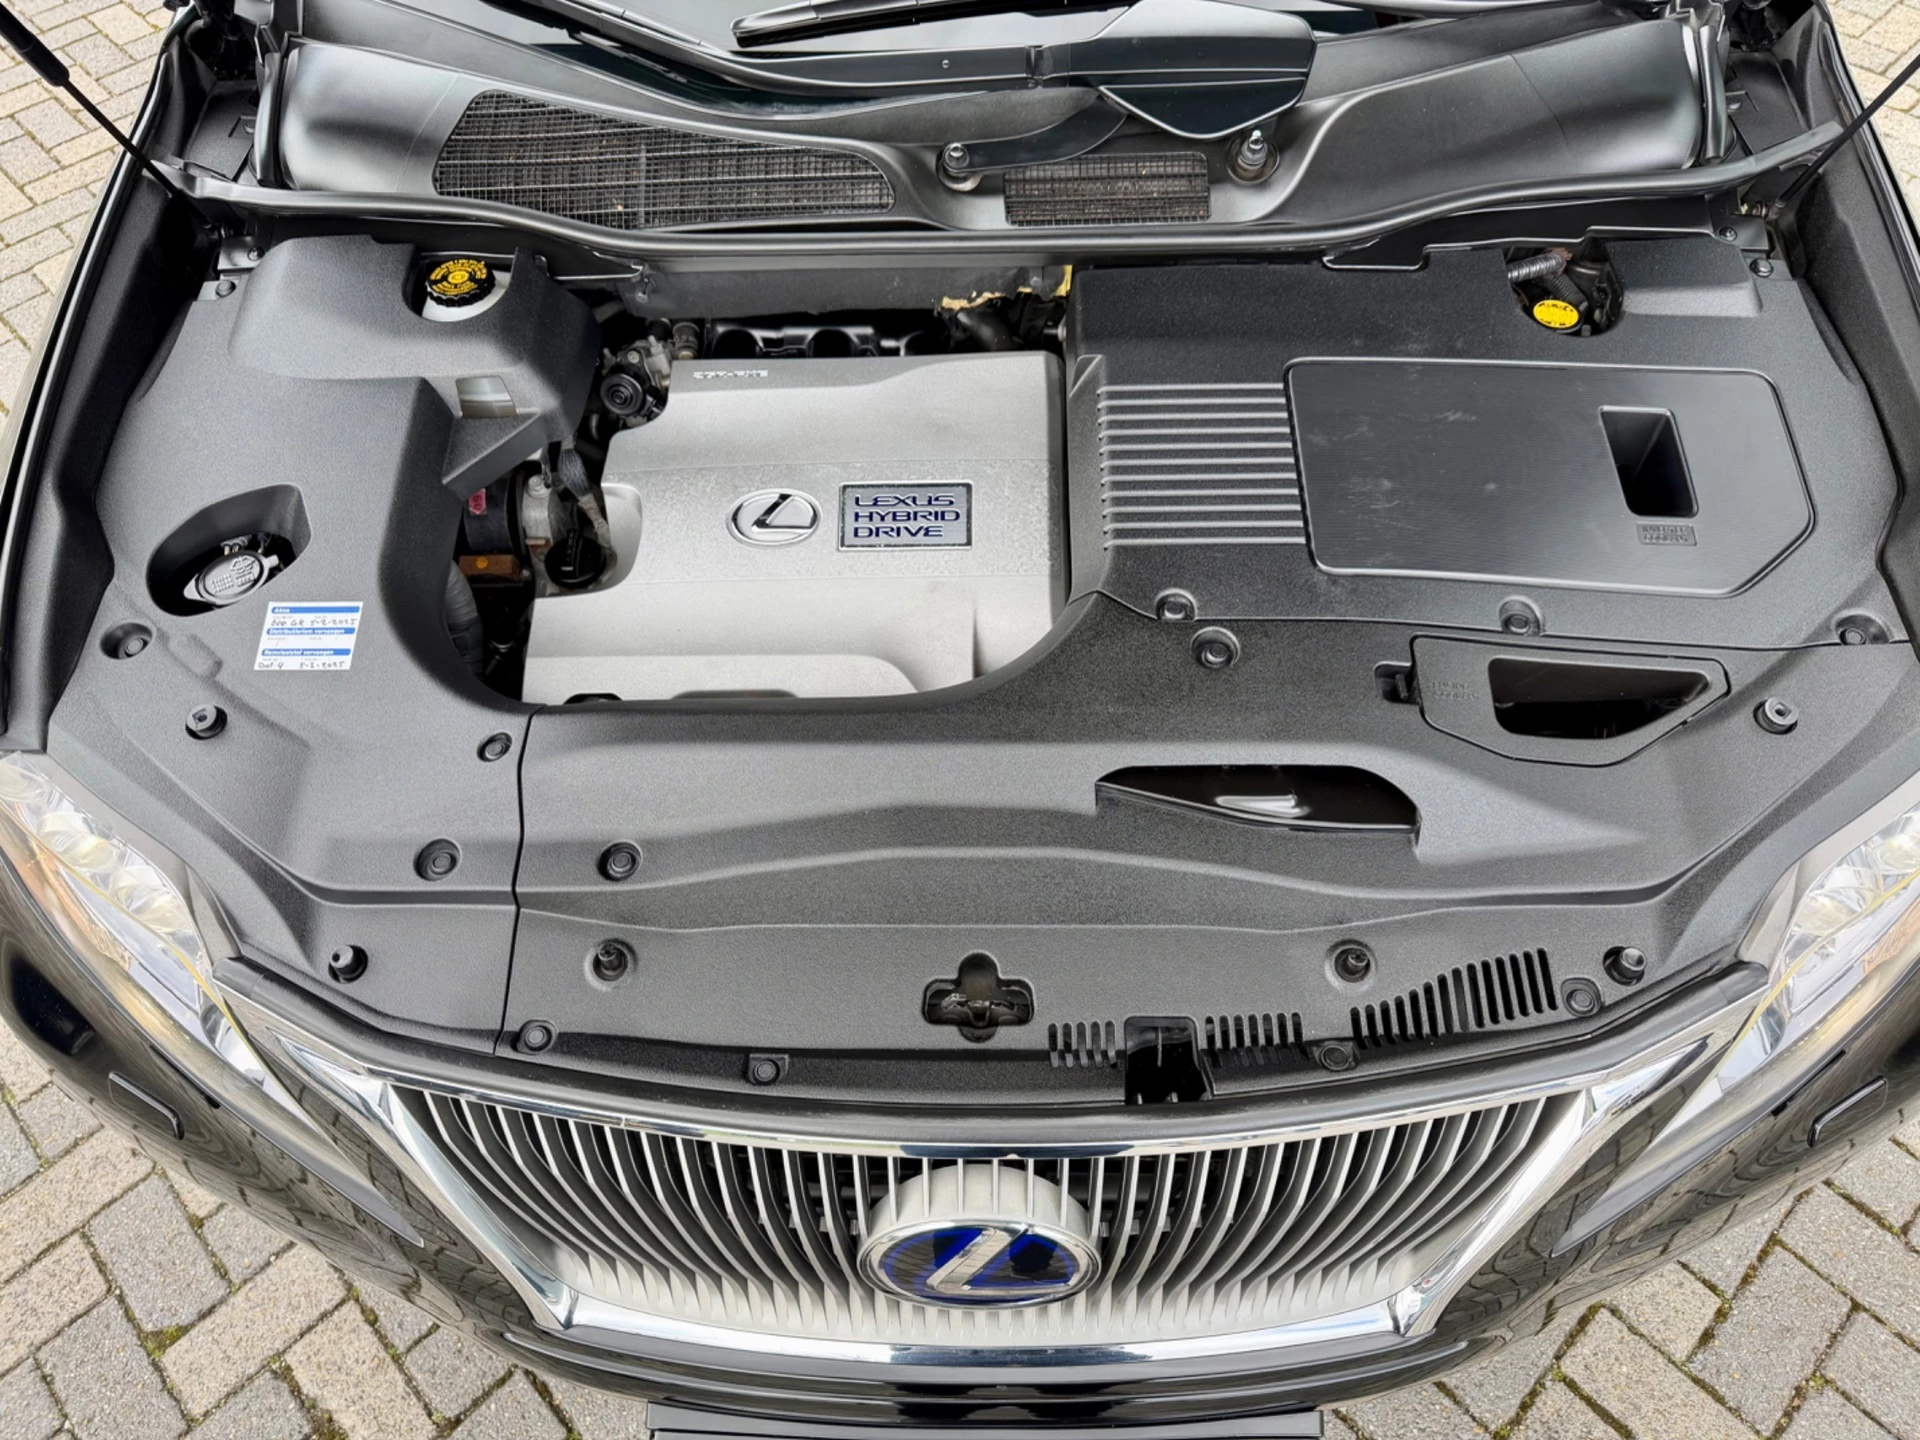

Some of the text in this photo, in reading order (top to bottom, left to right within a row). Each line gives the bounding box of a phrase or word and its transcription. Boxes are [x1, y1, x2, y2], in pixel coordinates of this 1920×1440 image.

[854, 494, 955, 508] LEXUS
[853, 509, 961, 523] HYBRID
[853, 525, 944, 539] DRIVE
